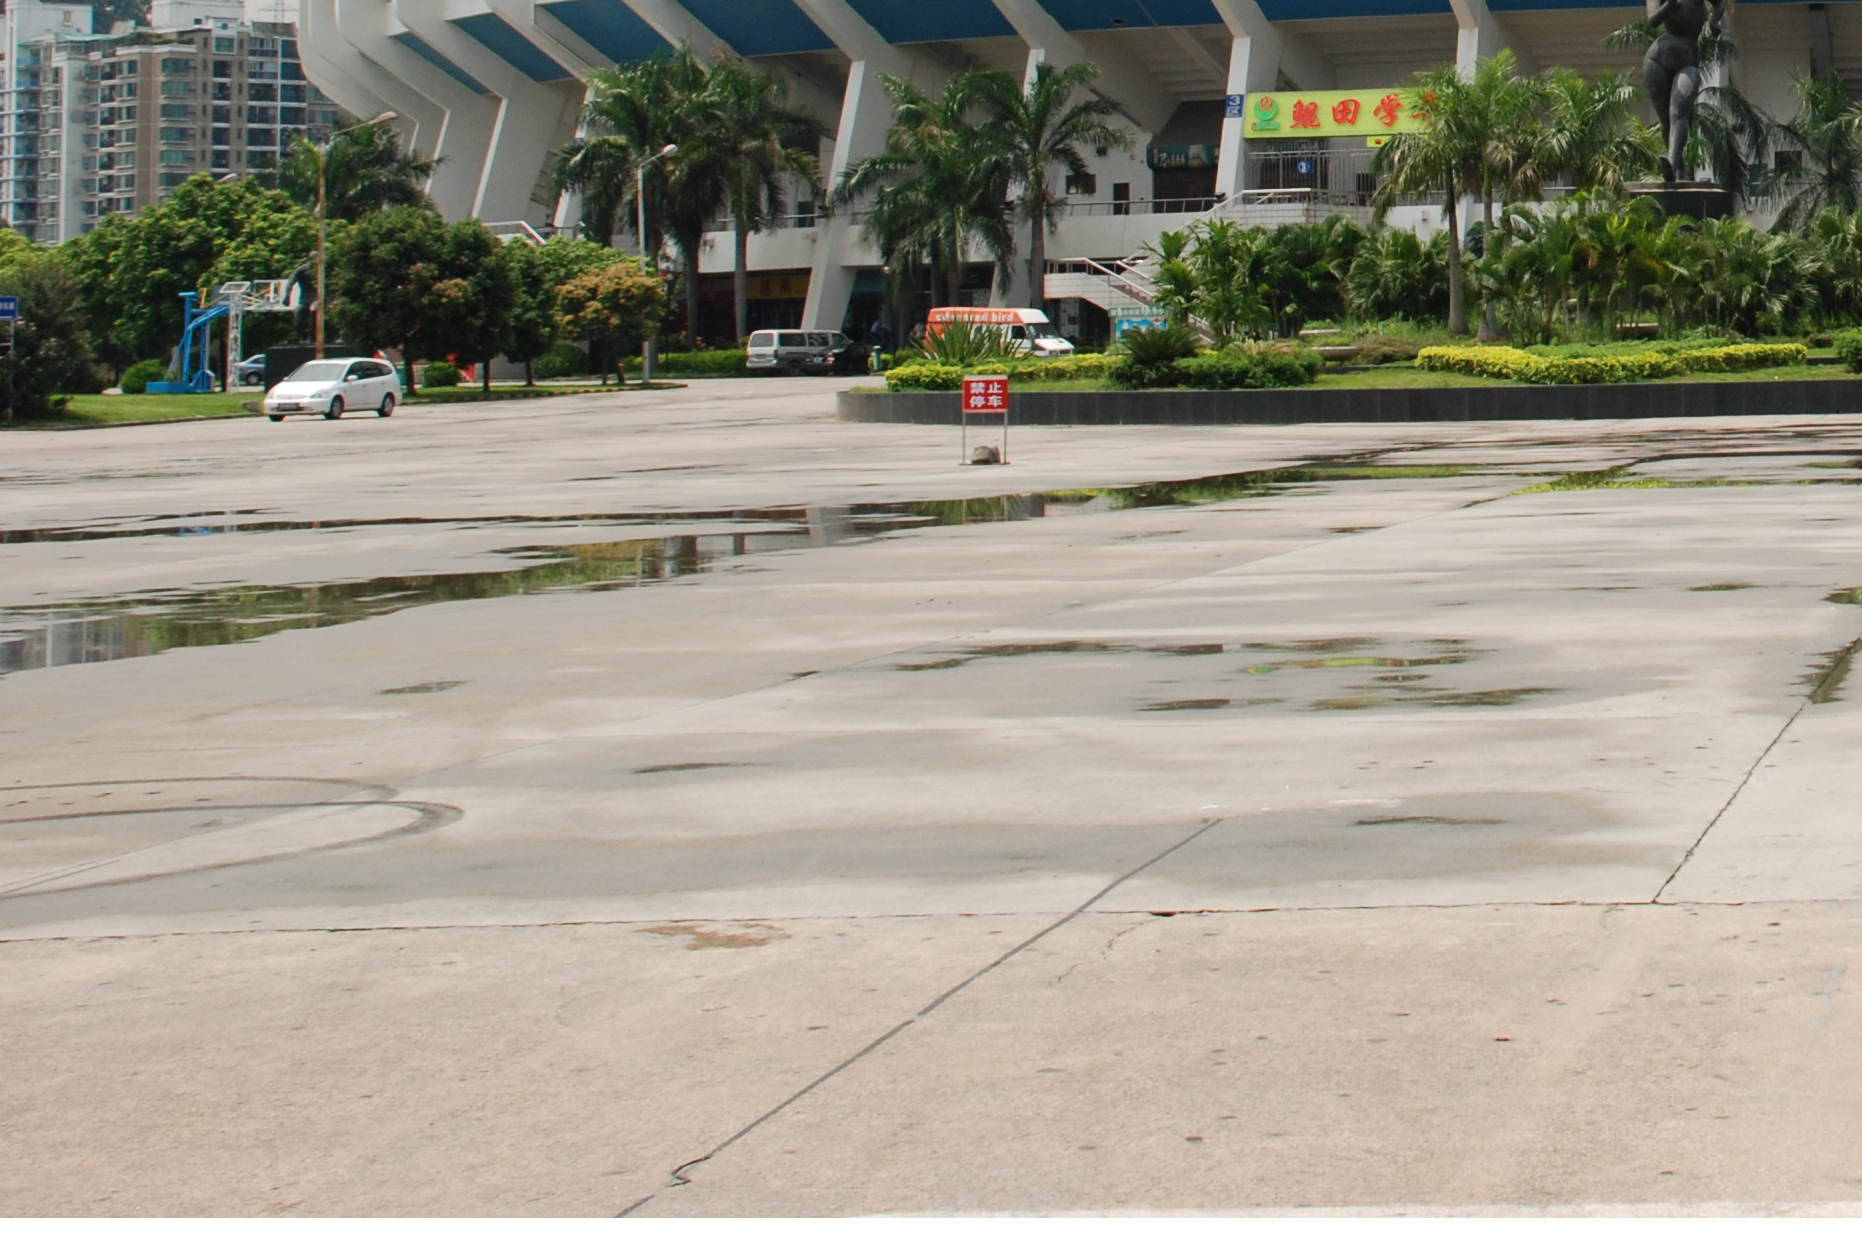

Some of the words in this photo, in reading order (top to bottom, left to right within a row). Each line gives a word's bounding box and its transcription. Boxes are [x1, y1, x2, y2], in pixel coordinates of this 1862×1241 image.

[991, 311, 1014, 321] bird
[970, 382, 1003, 394] 禁止
[969, 395, 1003, 407] 停车
